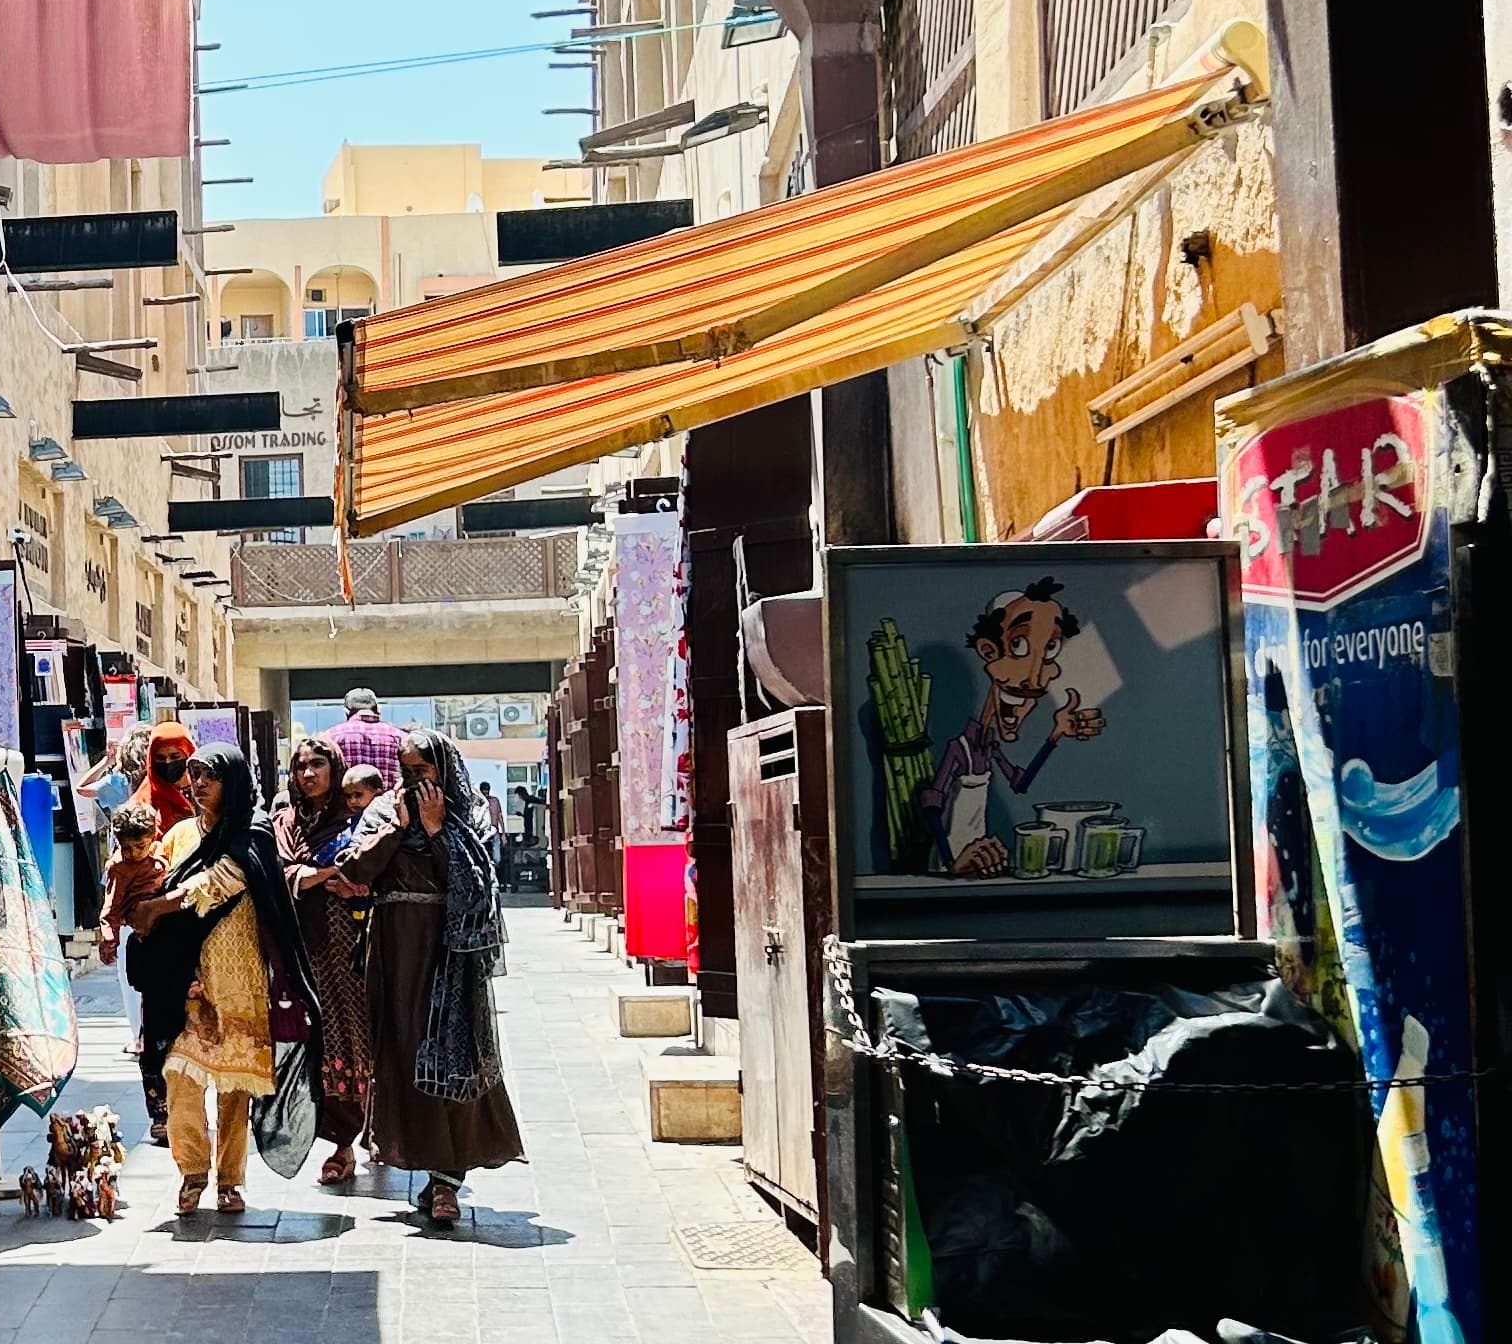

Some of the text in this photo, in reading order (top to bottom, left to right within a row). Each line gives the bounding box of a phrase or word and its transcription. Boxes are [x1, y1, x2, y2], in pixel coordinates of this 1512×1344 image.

[262, 431, 327, 449] TRADING
[1303, 629, 1329, 670] for
[1334, 620, 1425, 670] everyone
